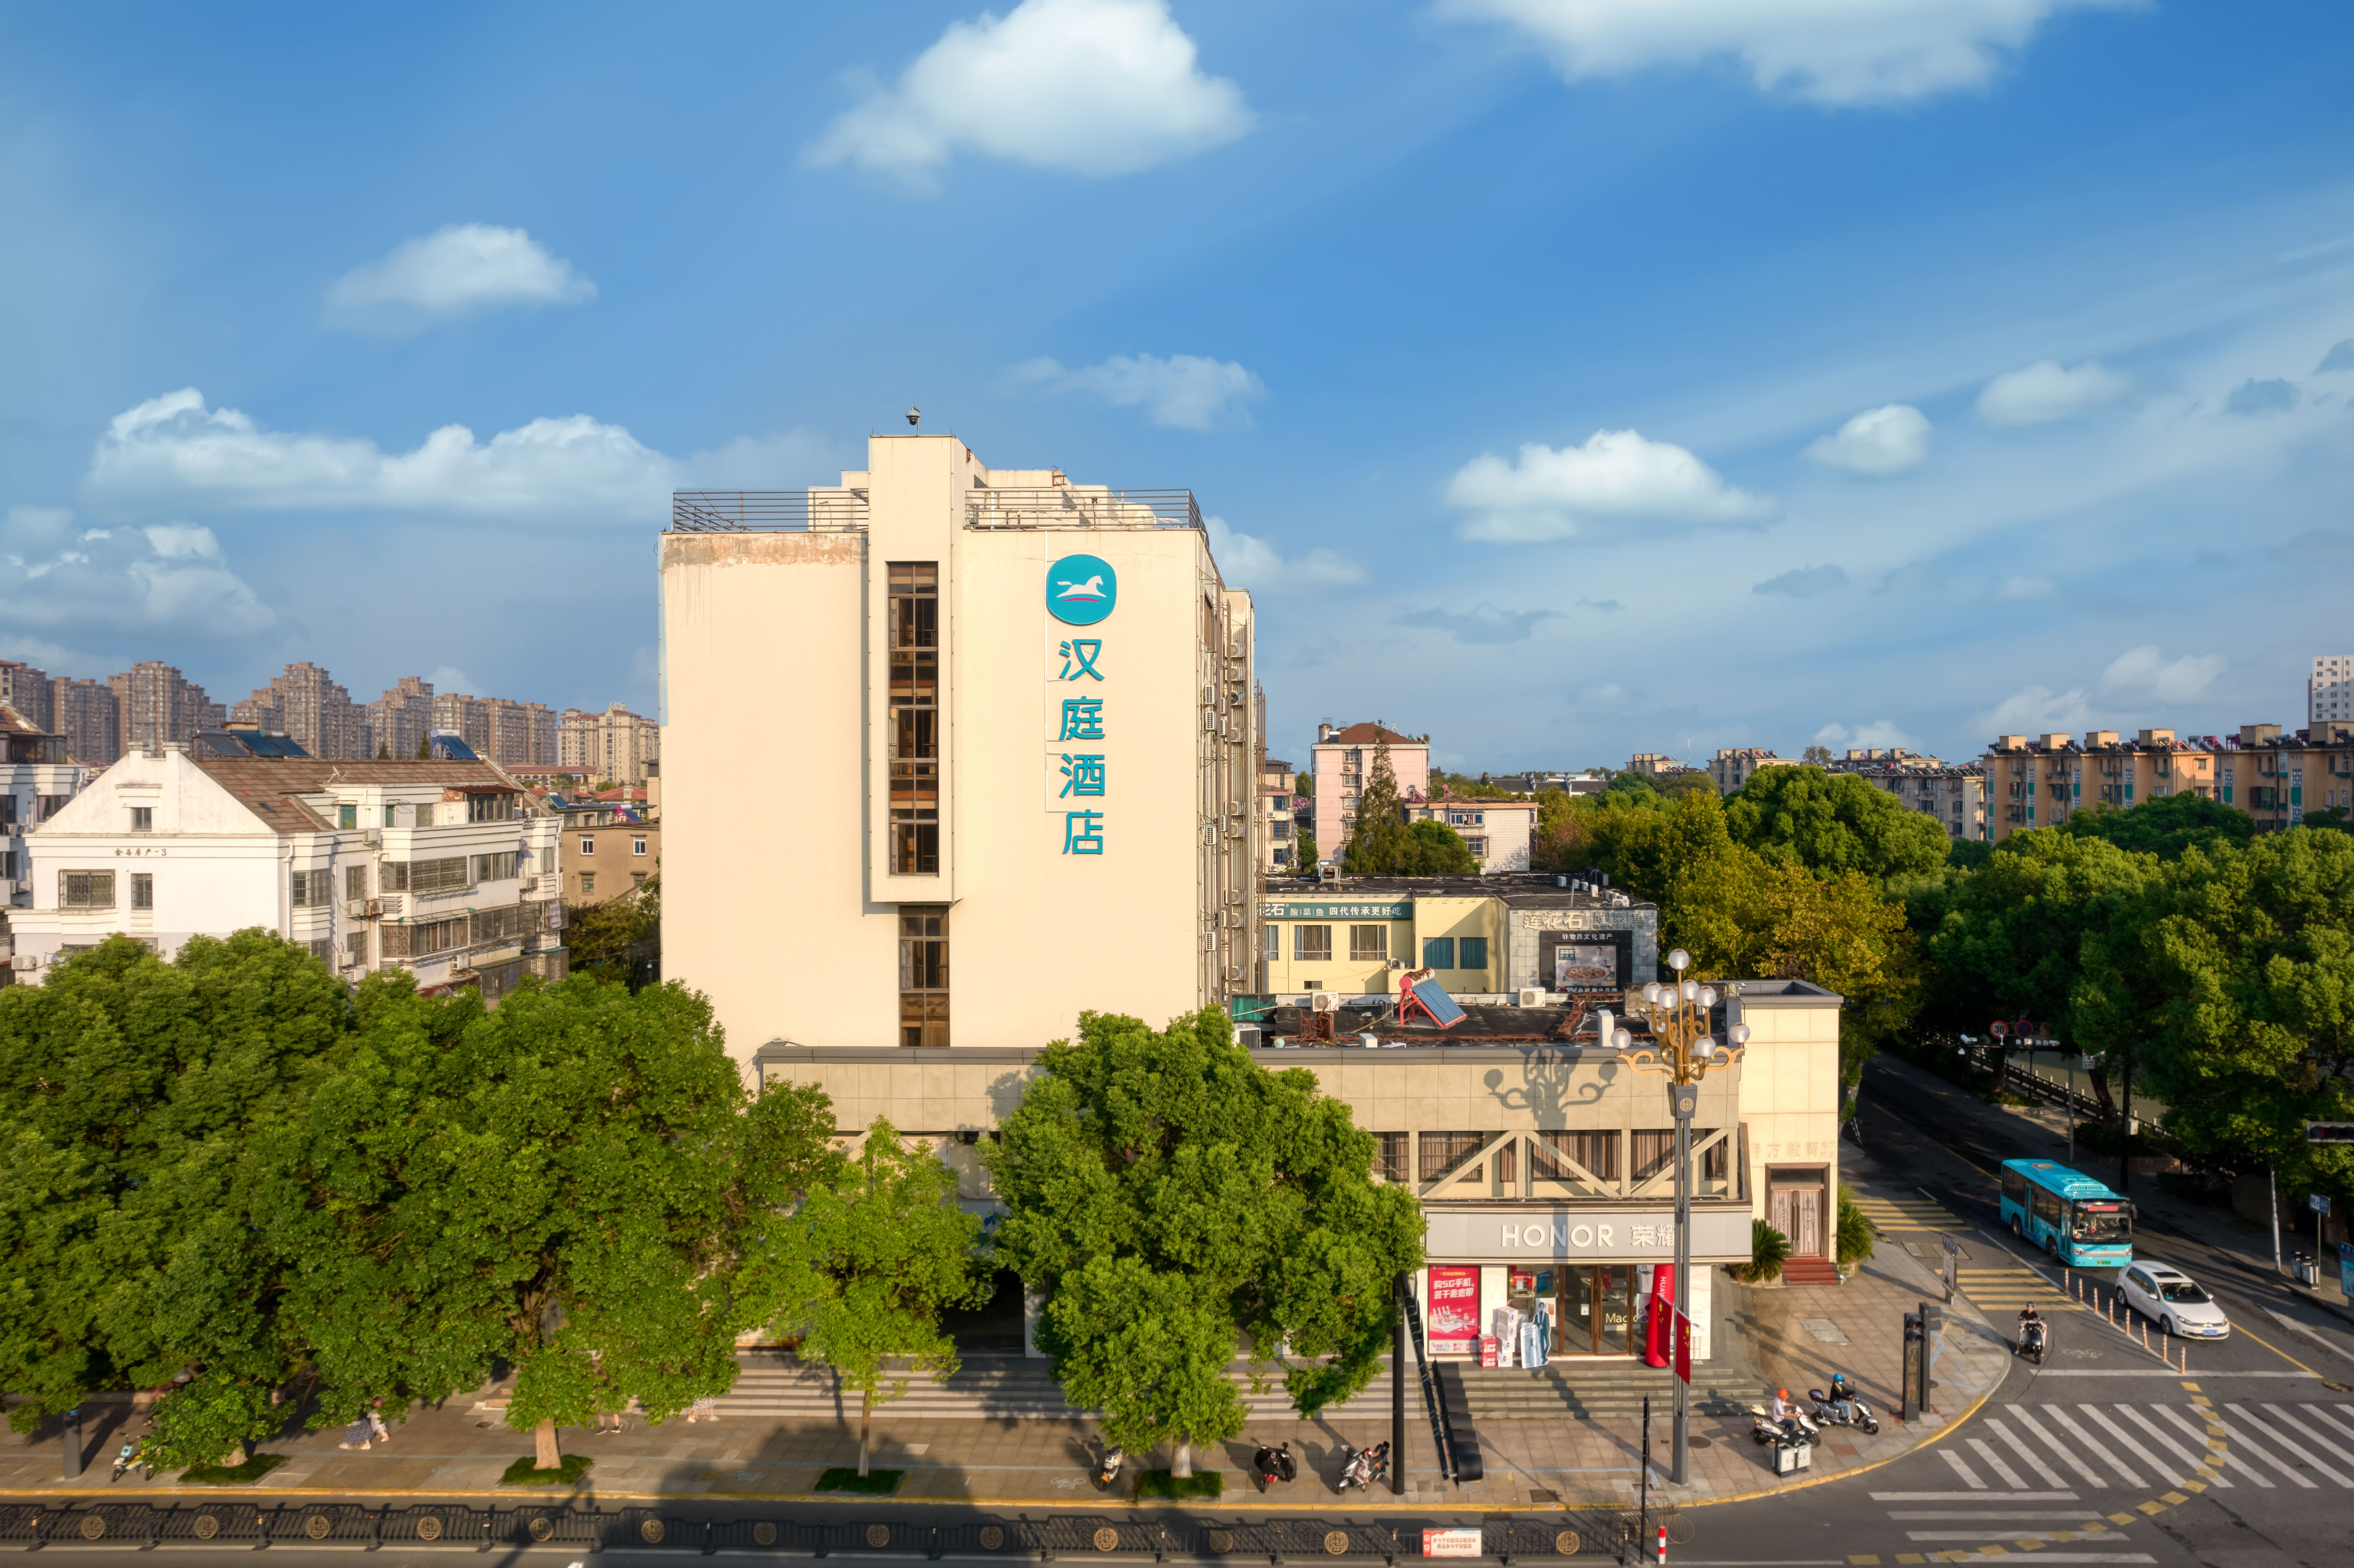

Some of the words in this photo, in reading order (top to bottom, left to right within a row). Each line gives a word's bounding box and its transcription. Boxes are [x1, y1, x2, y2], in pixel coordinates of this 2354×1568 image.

[1058, 638, 1105, 855] 汉庭酒店
[1330, 906, 1401, 916] 四代传承更好吃
[1523, 912, 1583, 930] 莲花石
[1501, 1225, 1614, 1248] HONOR
[1606, 1313, 1638, 1325] Magc
